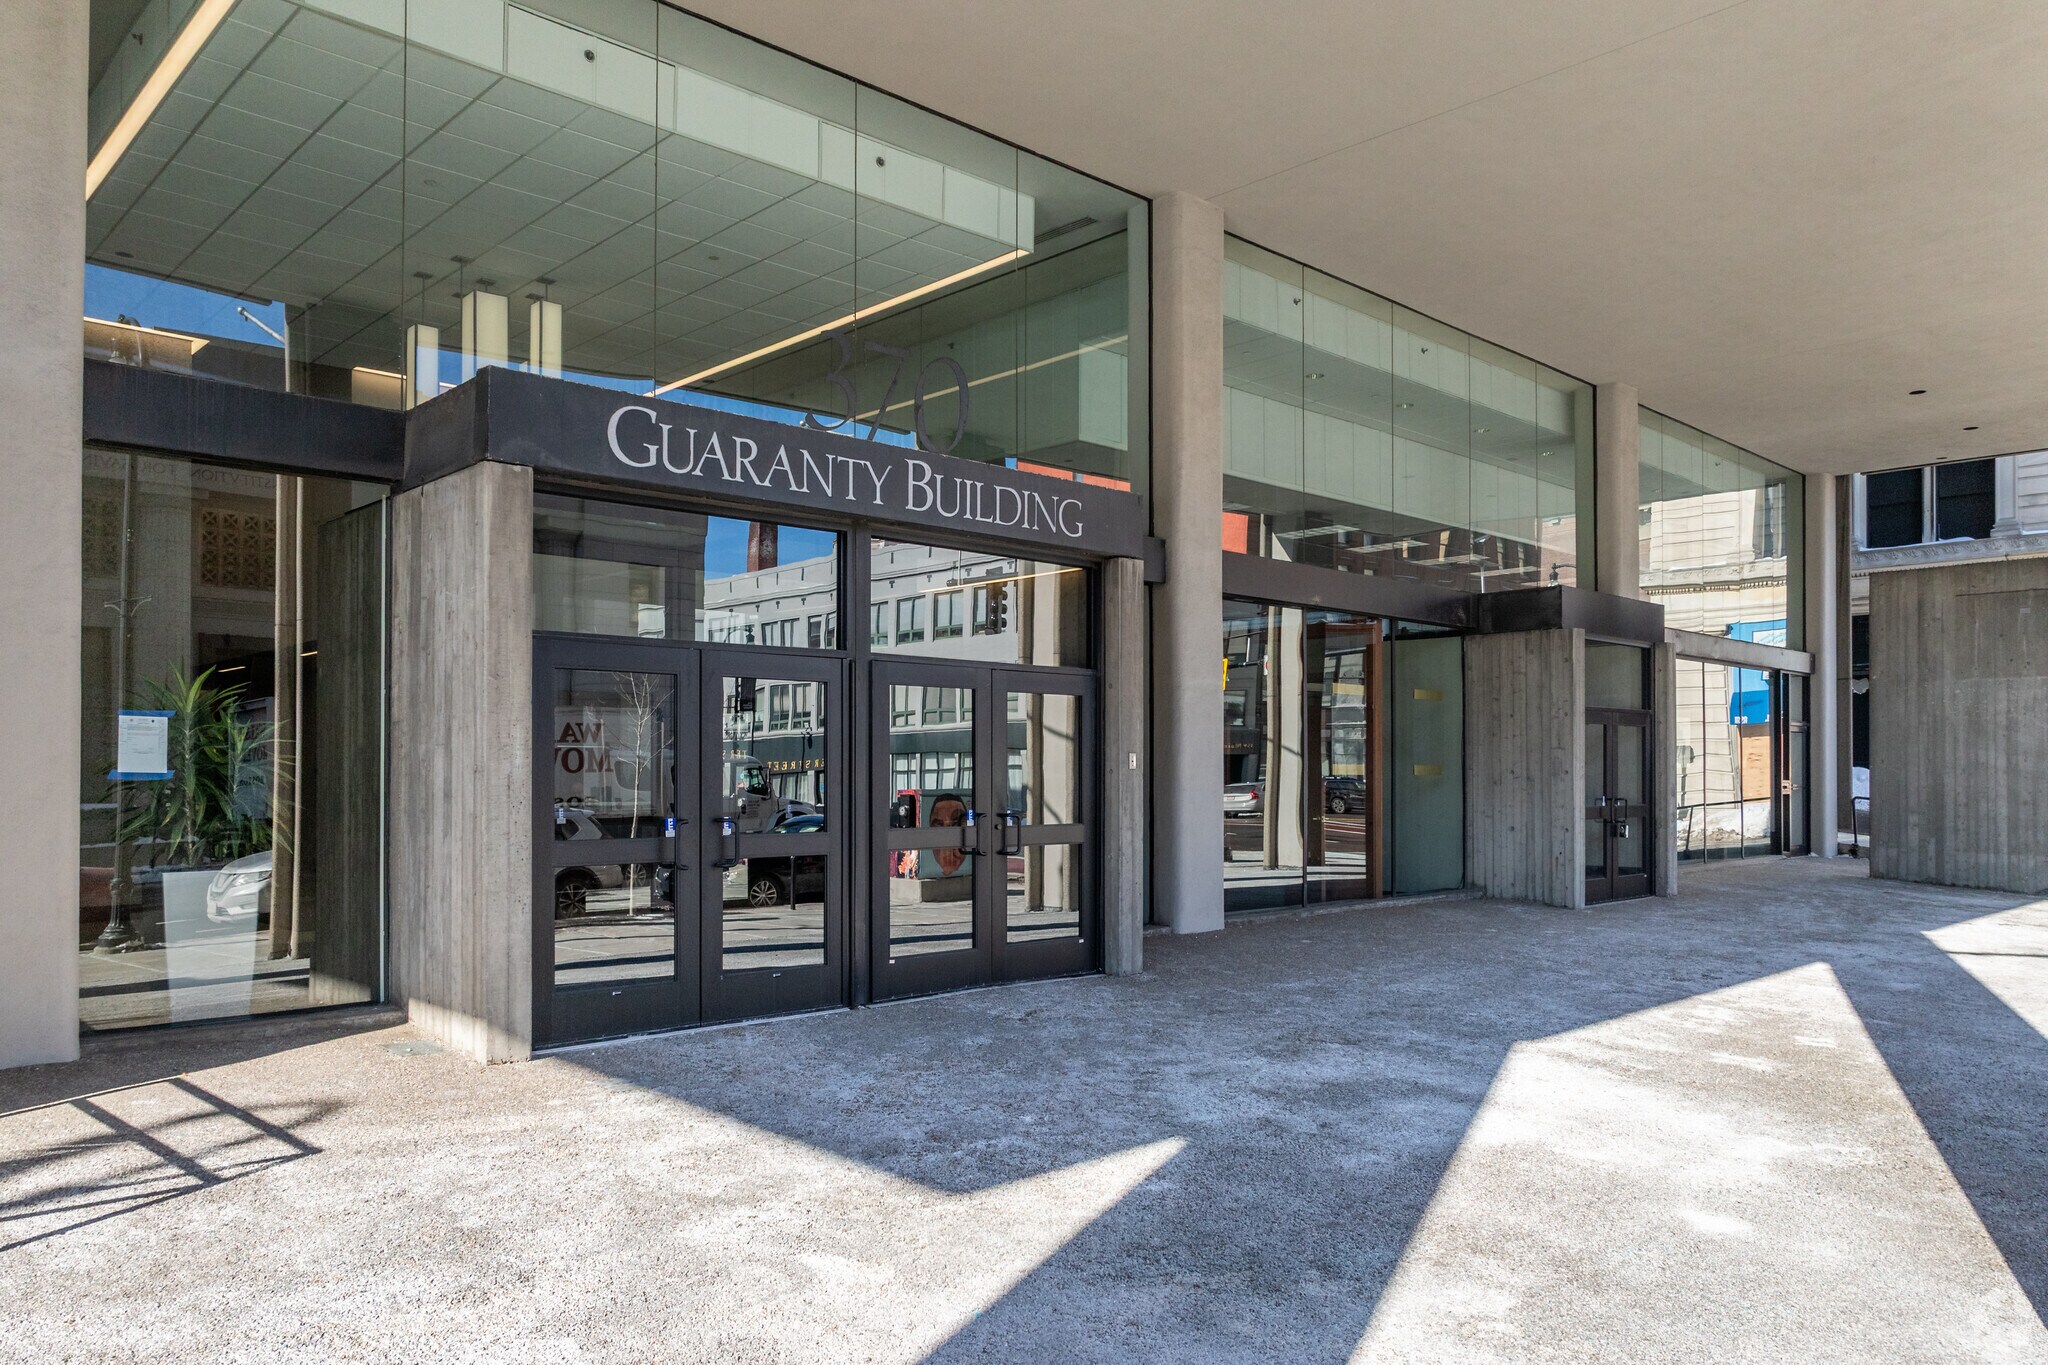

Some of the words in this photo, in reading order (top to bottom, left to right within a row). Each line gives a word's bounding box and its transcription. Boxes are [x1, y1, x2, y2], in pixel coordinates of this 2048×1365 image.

[805, 330, 969, 452] 370
[607, 405, 893, 505] GUARANTY
[905, 459, 1084, 538] BUILDING
